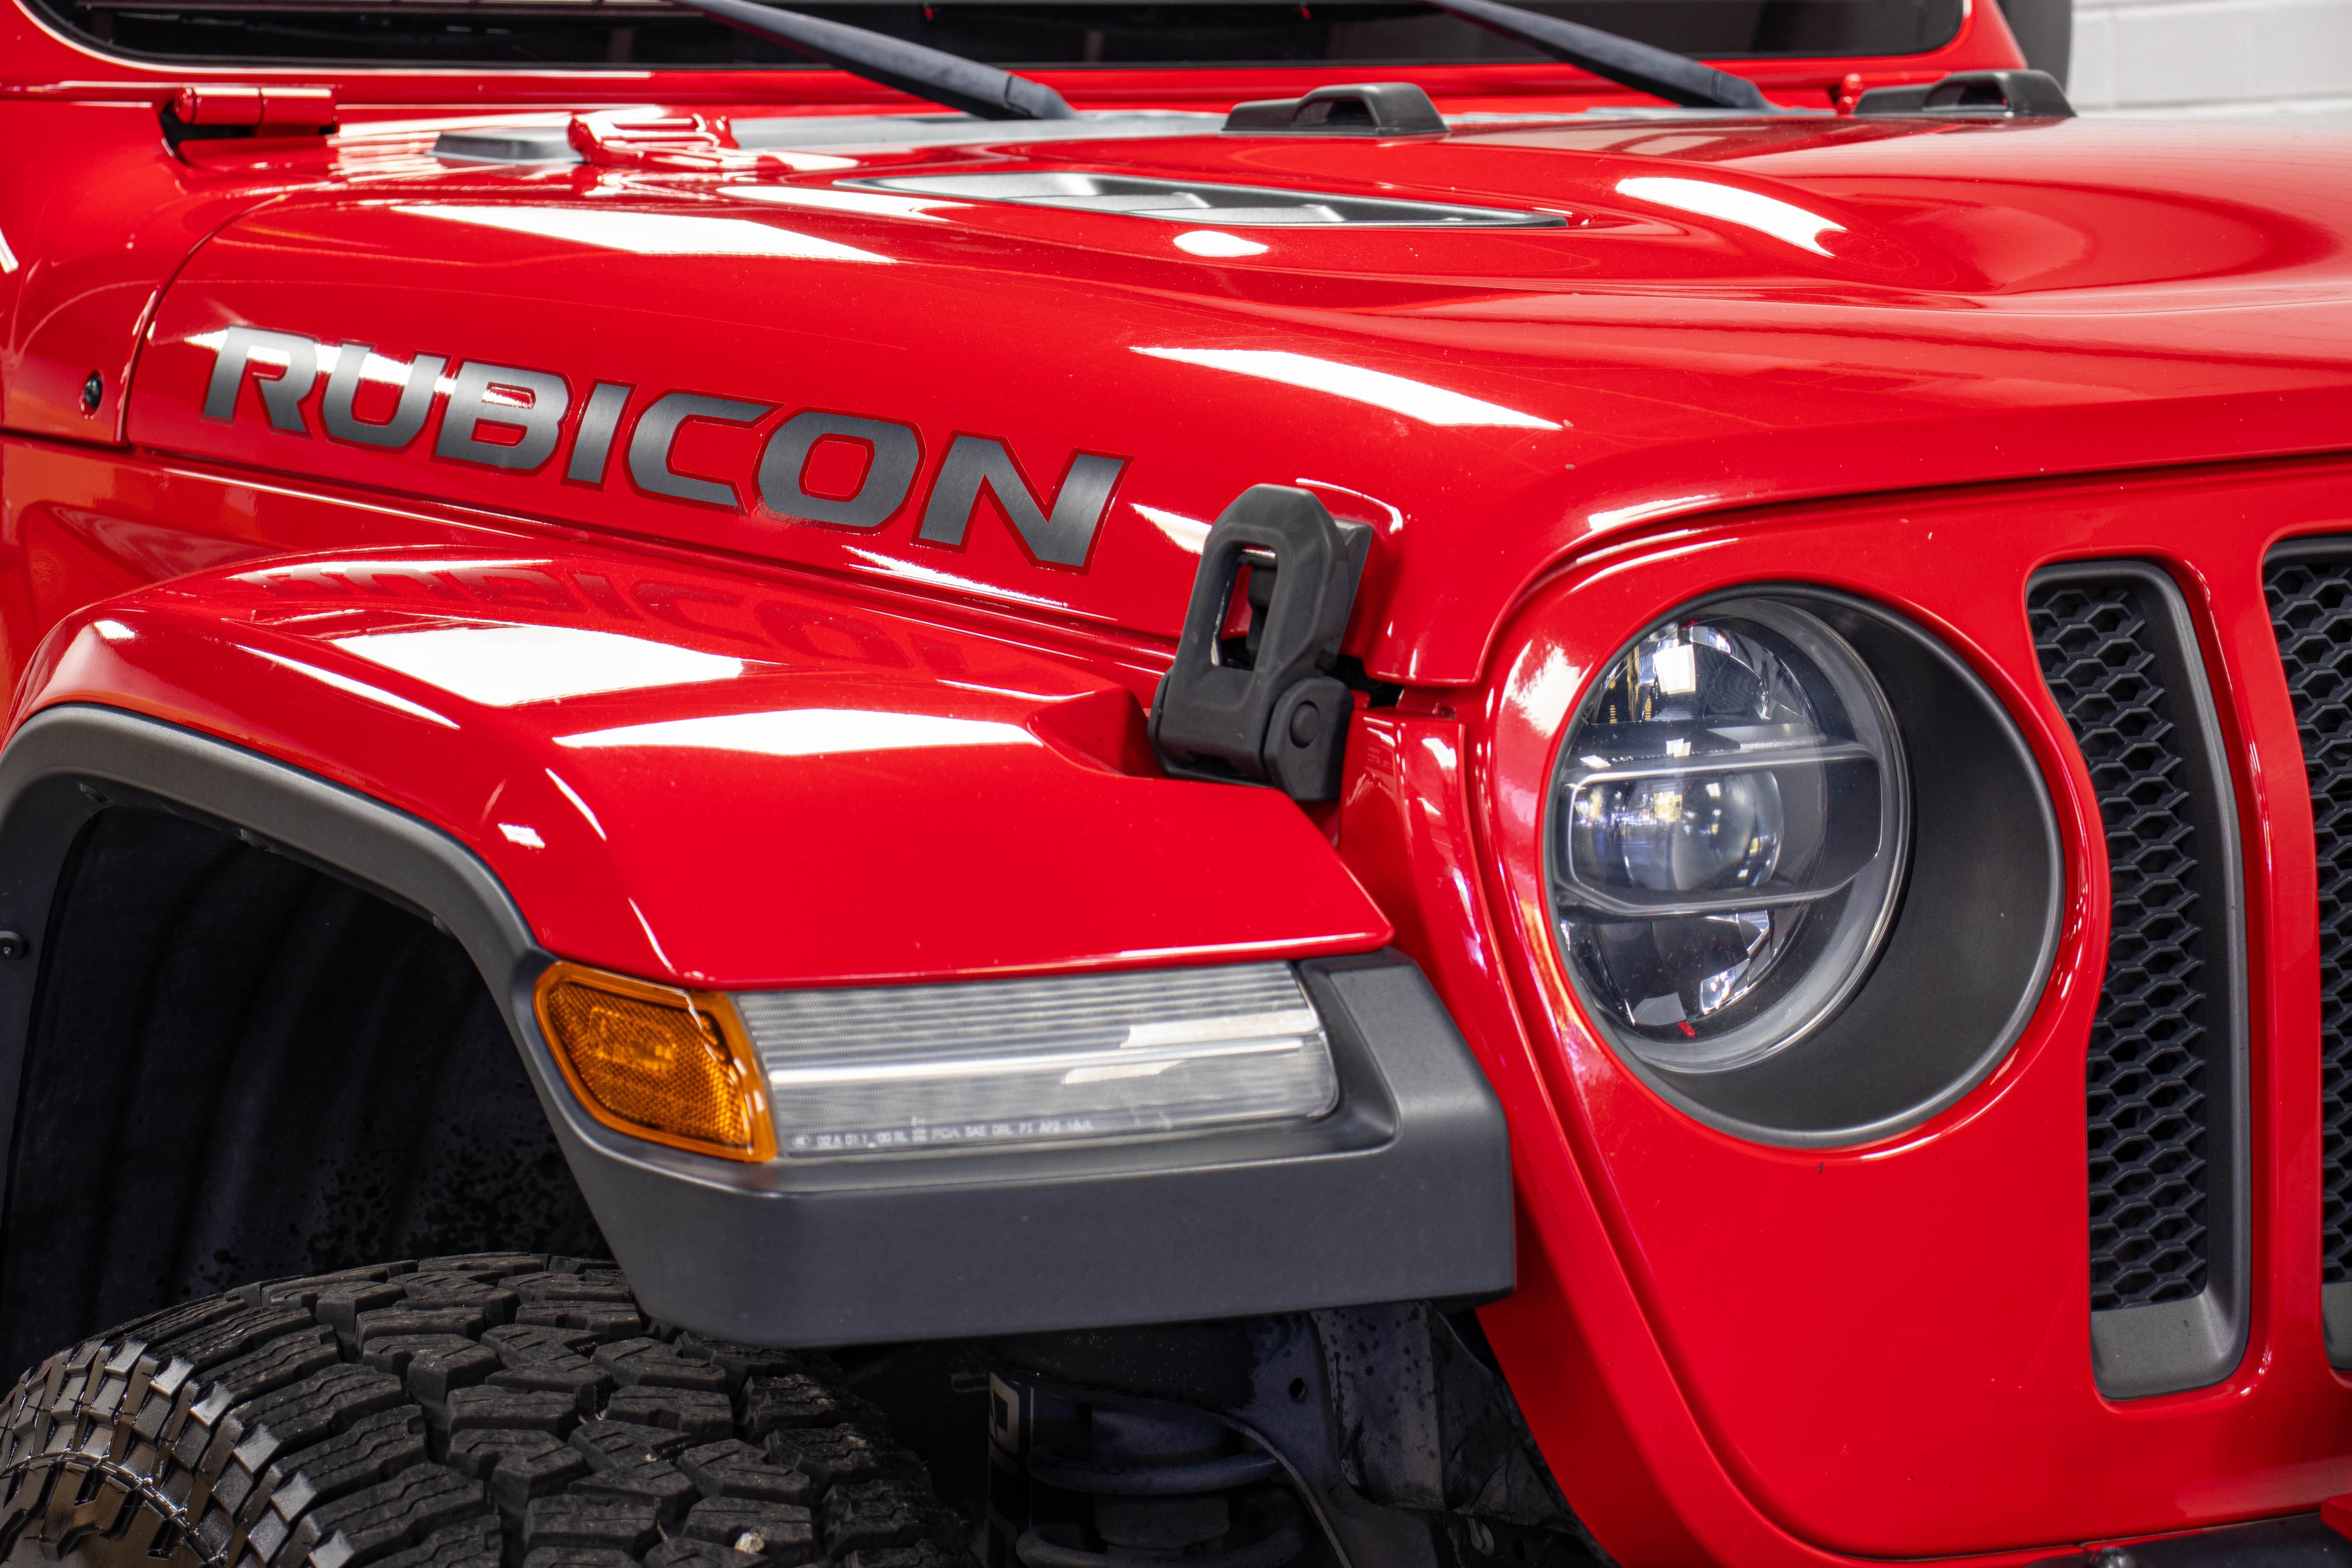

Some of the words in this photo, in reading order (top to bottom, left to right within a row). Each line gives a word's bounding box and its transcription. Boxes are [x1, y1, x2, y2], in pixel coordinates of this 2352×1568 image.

[205, 325, 1132, 572] RUBICON
[964, 1124, 986, 1137] SAE
[991, 1123, 1013, 1136] DRL
